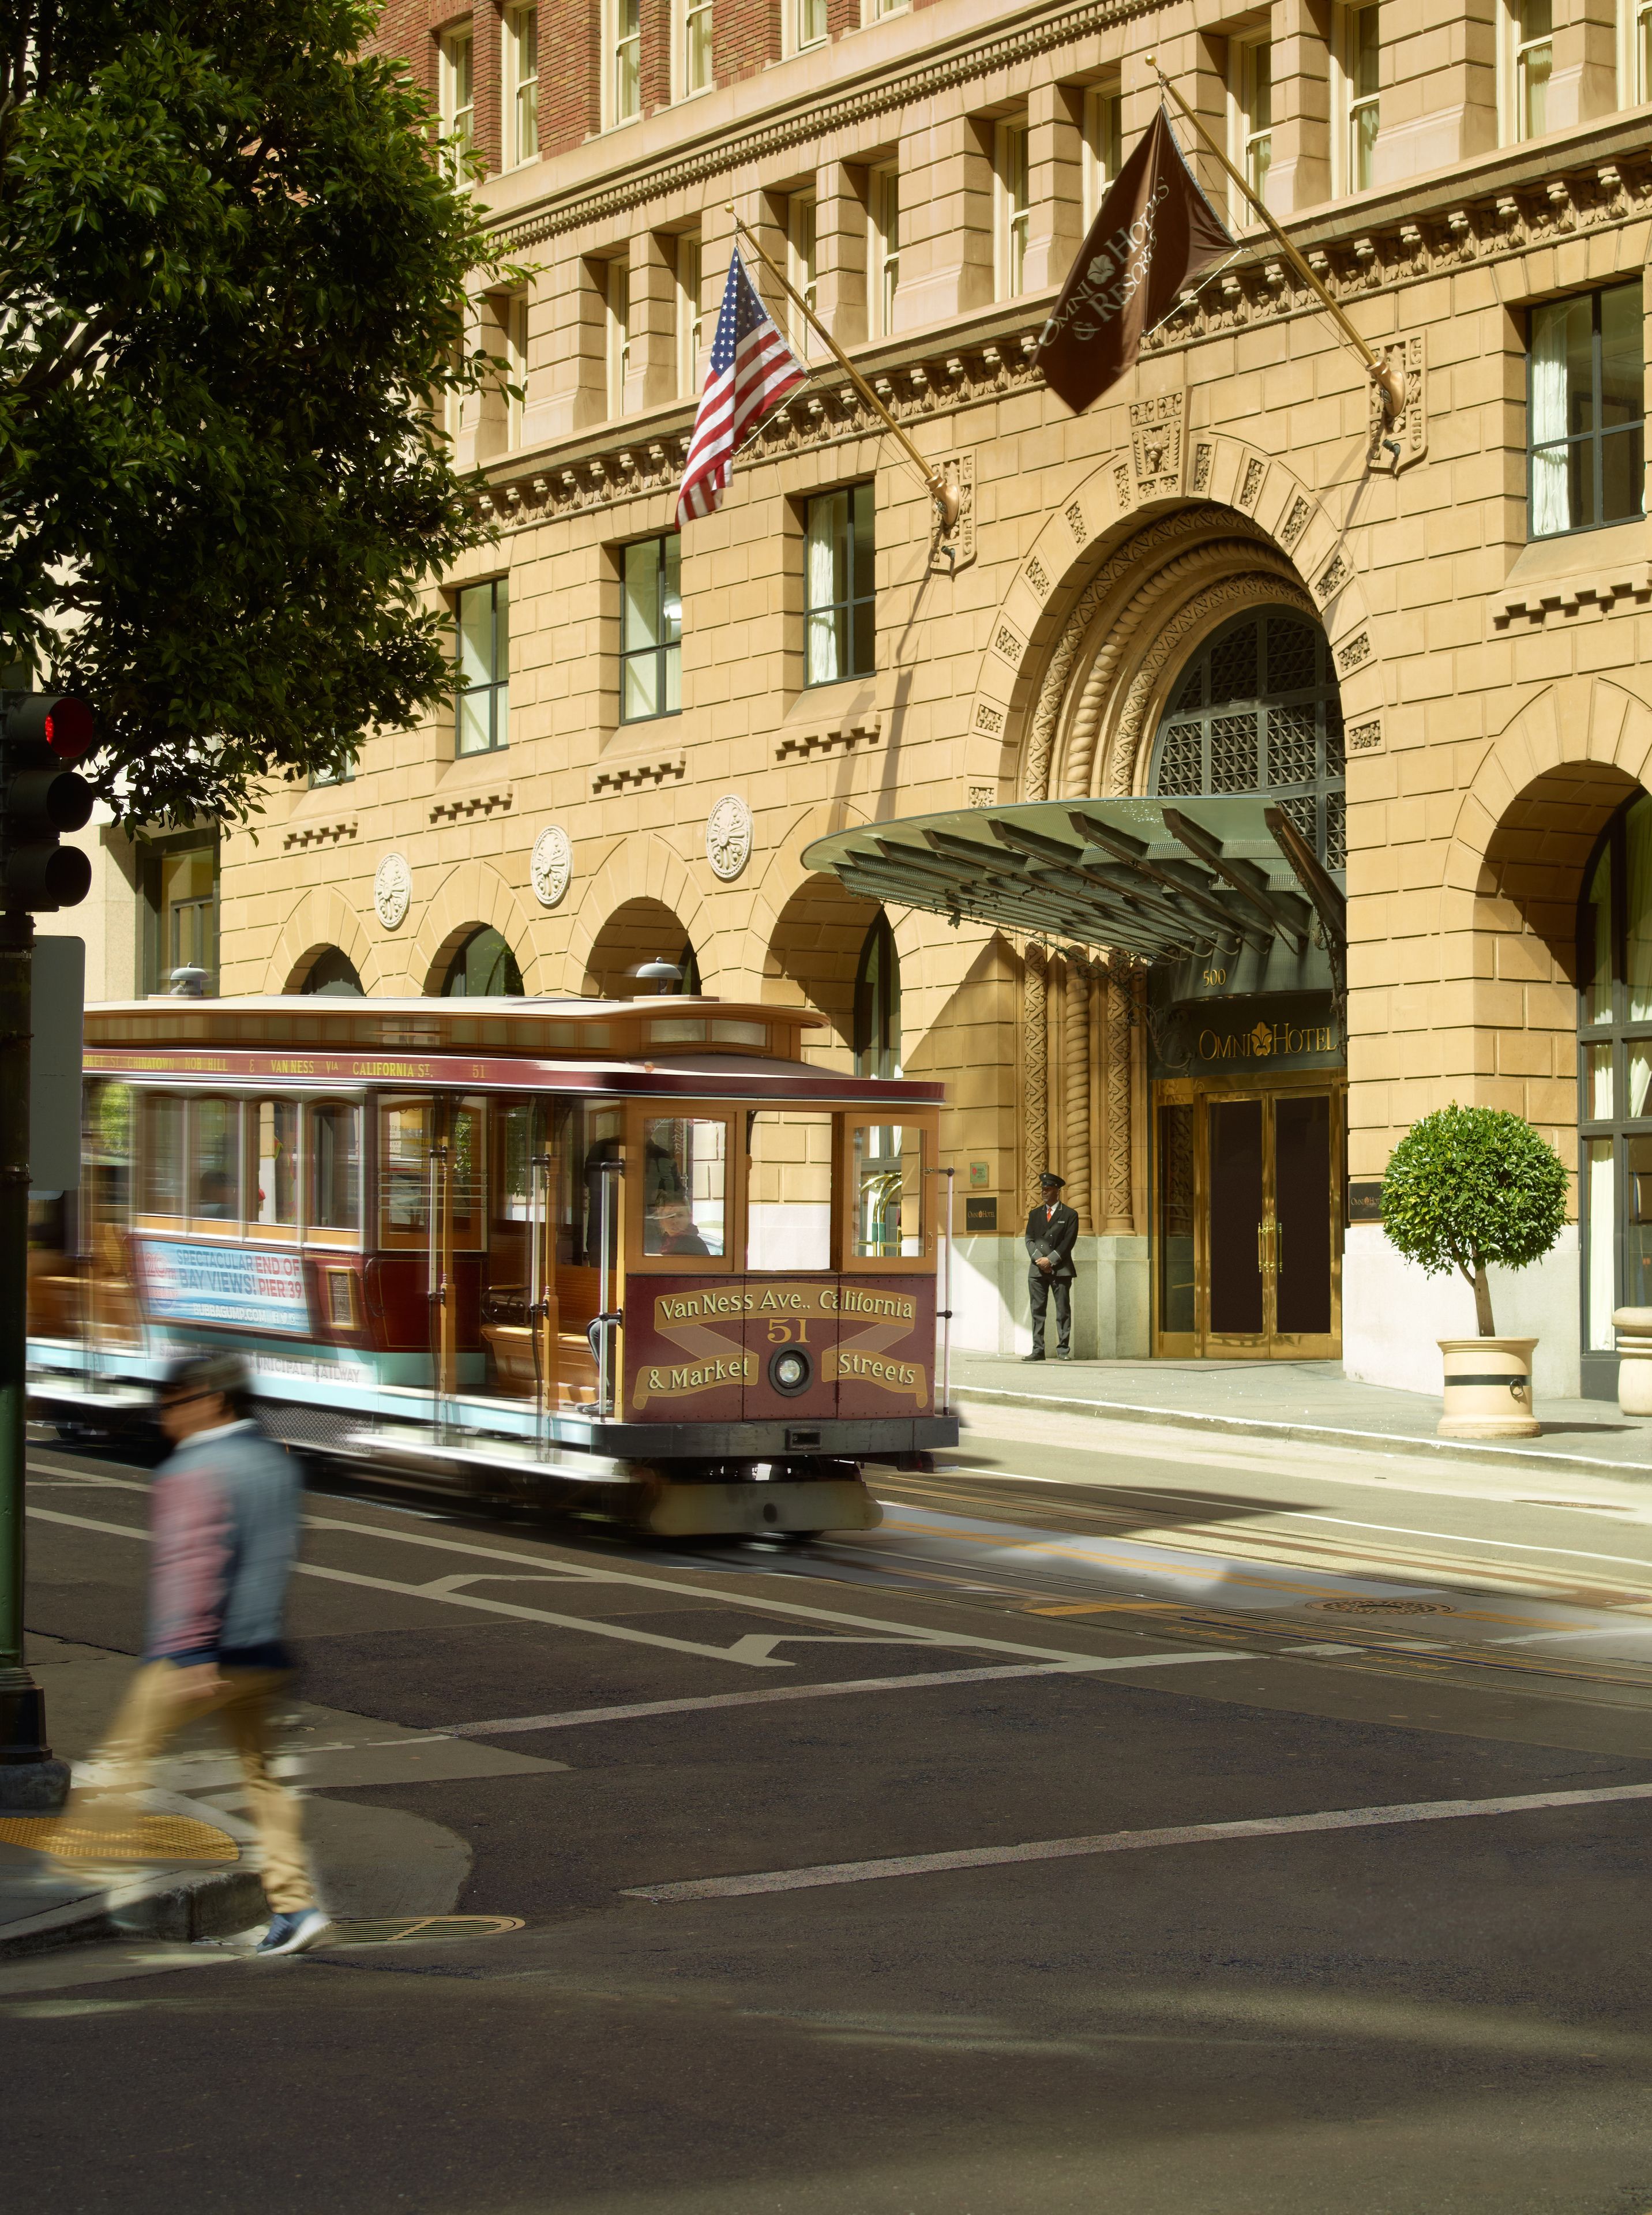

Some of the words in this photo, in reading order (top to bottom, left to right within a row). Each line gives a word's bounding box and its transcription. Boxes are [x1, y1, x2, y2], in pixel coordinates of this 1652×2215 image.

[1038, 279, 1095, 346] OMNI
[1072, 321, 1101, 341] &
[1203, 968, 1227, 987] 500
[1199, 1029, 1252, 1060] OMNI
[1271, 1023, 1339, 1055] HOTEL
[82, 1054, 104, 1068] RKET
[127, 1057, 174, 1071] CHINATOWN
[185, 1057, 202, 1070] NOB
[208, 1058, 228, 1071] HILL
[271, 1060, 288, 1073] VAN
[291, 1060, 314, 1073] NESS
[352, 1061, 415, 1078] CALIFORNIA
[472, 1065, 486, 1078] 51
[176, 1249, 254, 1272] SPECTACULAR
[256, 1256, 280, 1275] END
[283, 1258, 300, 1277] OF
[179, 1268, 204, 1290] BAY
[206, 1271, 257, 1296] VIEWS!
[259, 1279, 286, 1297] PIER
[289, 1281, 302, 1299] 39
[193, 1302, 267, 1322] BUBBAGUMP.COM
[660, 1299, 699, 1320] Van
[702, 1290, 754, 1313] Ness
[819, 1290, 913, 1319] California
[767, 1319, 810, 1343] 51
[313, 1364, 360, 1383] RAILWAY
[648, 1369, 666, 1390] &
[671, 1357, 749, 1388] Market
[839, 1353, 916, 1385] Streets
